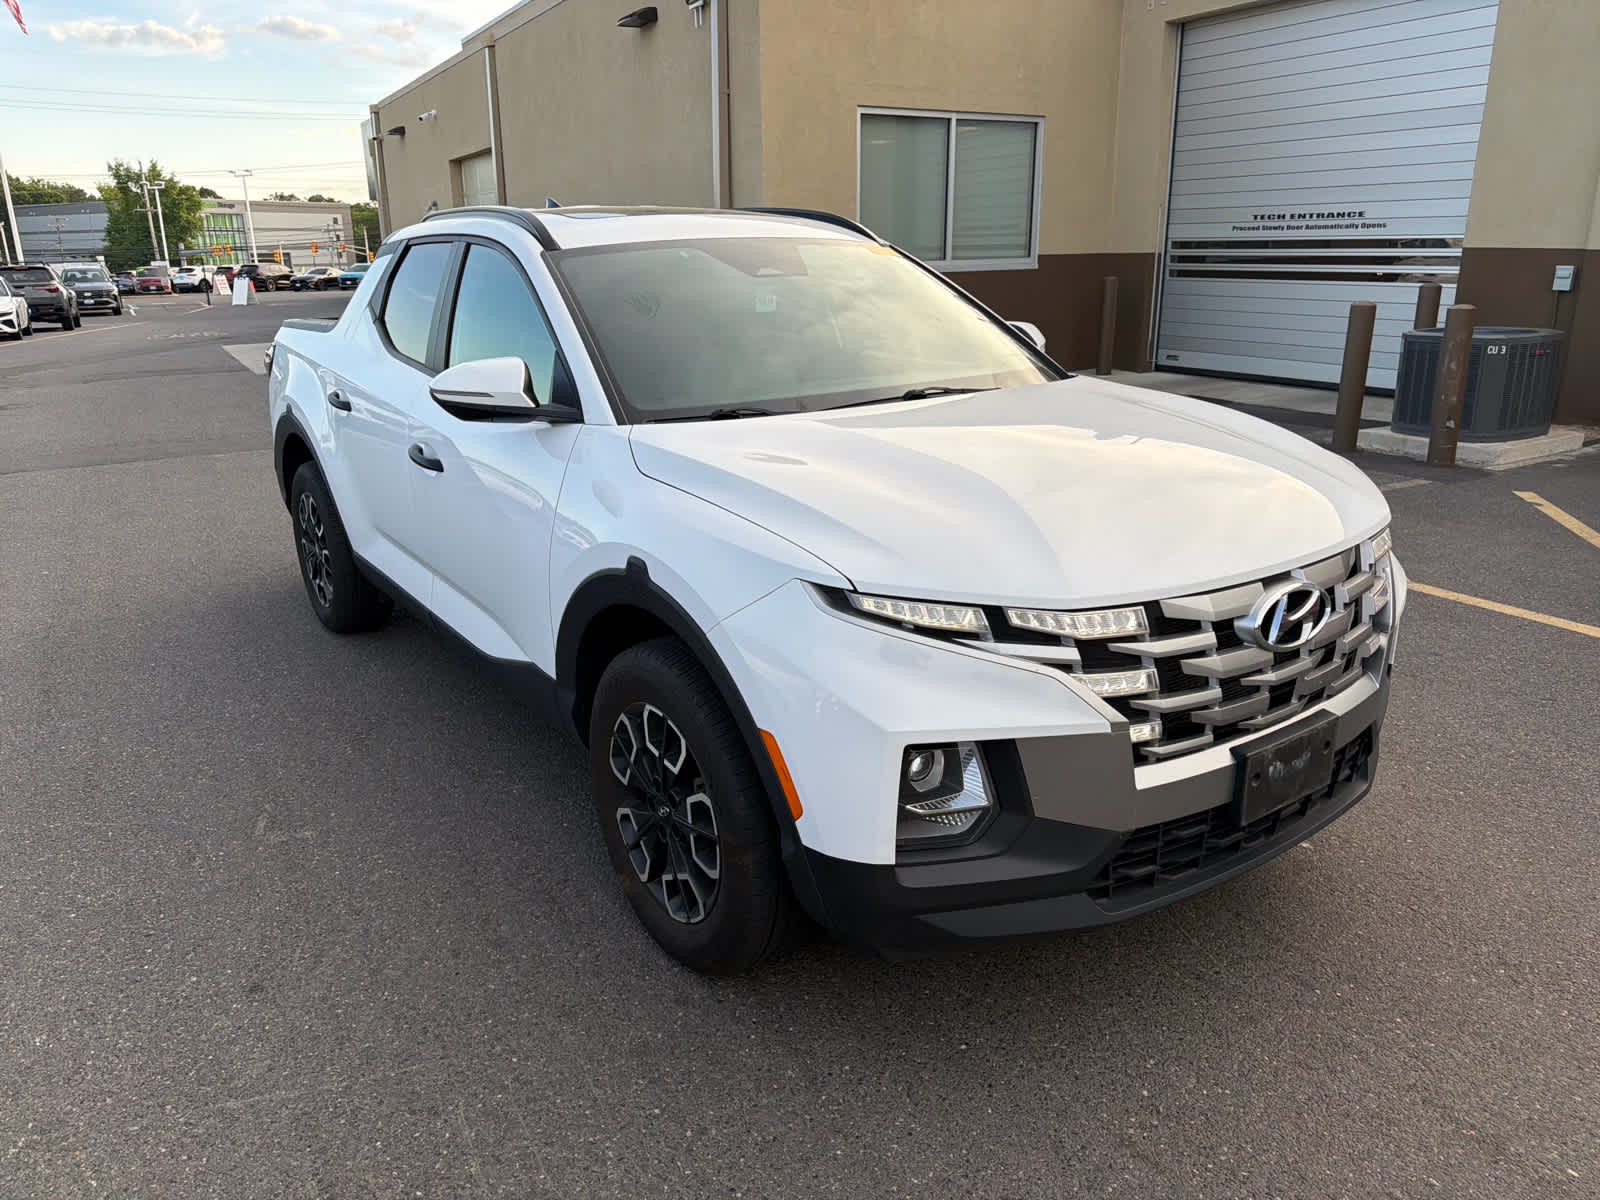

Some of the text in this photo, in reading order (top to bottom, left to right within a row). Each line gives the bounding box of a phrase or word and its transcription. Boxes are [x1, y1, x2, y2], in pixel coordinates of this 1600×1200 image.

[1252, 210, 1366, 221] TECH ENTRANCE
[1305, 223, 1360, 231] Automatically
[1487, 345, 1506, 354] CU 3
